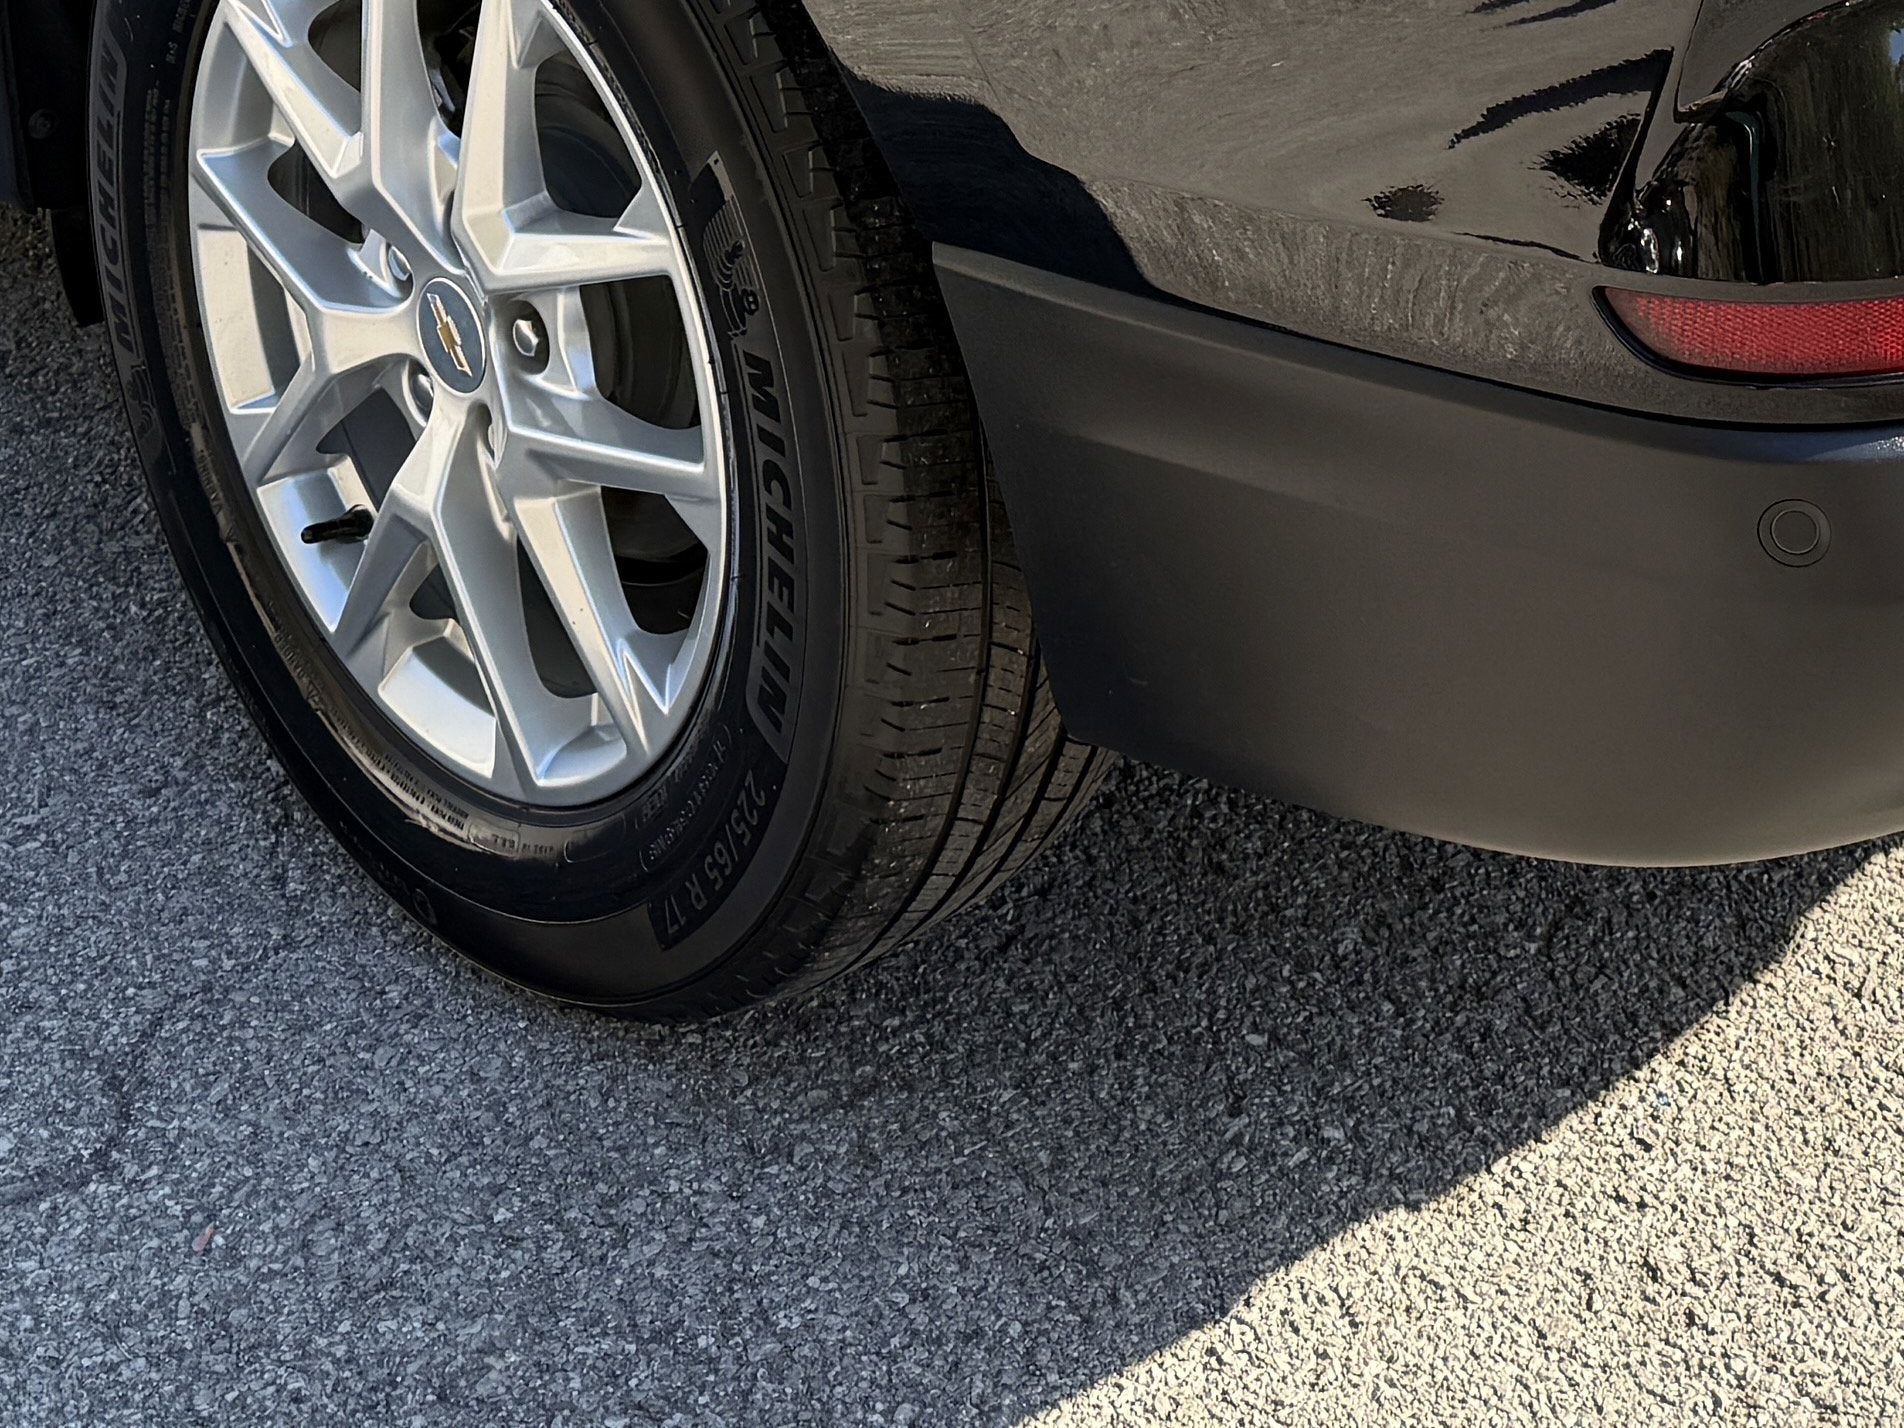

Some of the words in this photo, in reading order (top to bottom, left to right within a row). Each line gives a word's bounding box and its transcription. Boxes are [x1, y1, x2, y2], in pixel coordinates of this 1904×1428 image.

[98, 42, 134, 354] MICHELIN
[742, 348, 795, 733] MICHELIN
[684, 872, 709, 912] R
[703, 768, 767, 892] 225/65
[664, 895, 687, 935] 17
